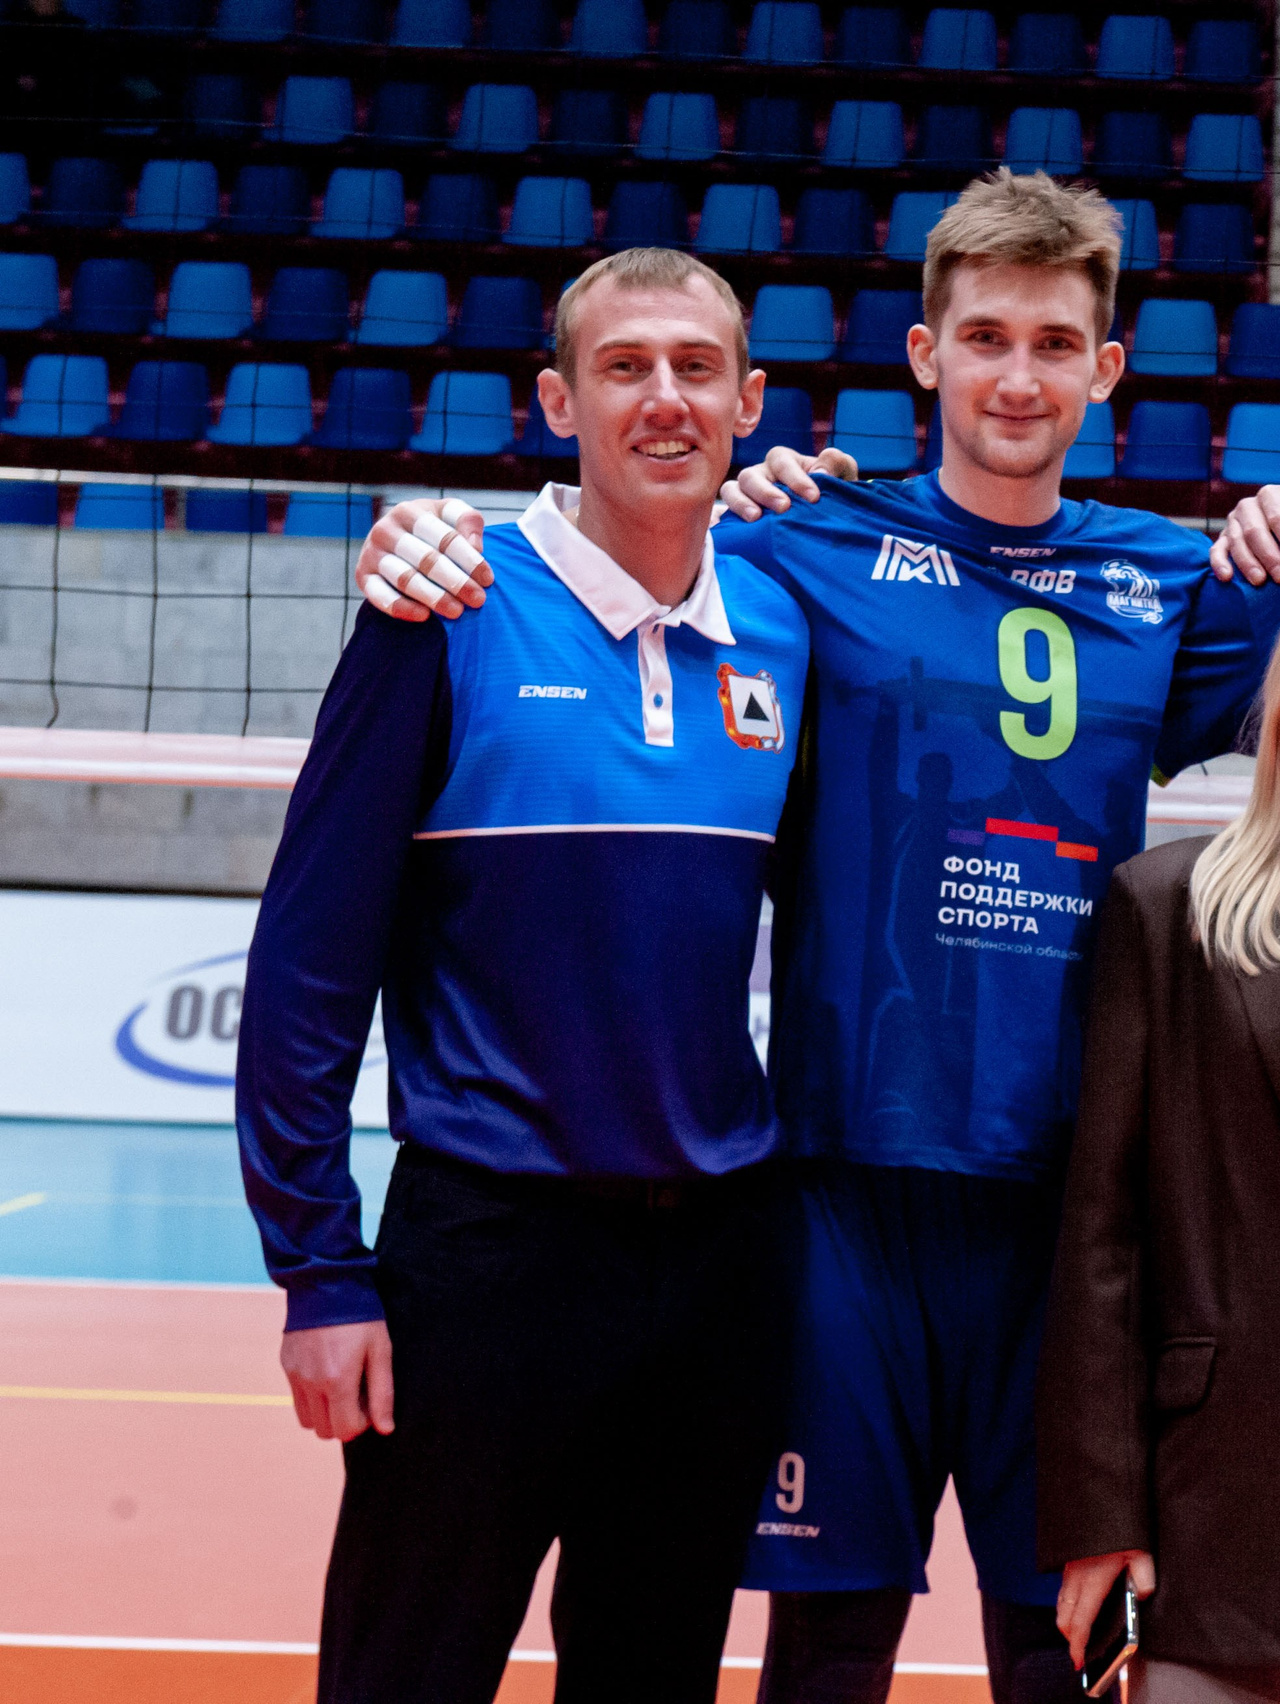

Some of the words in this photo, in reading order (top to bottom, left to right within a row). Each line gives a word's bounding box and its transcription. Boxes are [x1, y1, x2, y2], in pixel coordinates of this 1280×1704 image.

[989, 546, 1057, 558] ENSEN
[518, 685, 587, 700] ENSEN
[997, 606, 1078, 761] 9
[943, 855, 1020, 884] ФОНД
[939, 880, 1094, 917] ПОДДЕРЖКИ
[937, 906, 1039, 935] СПОРТА
[936, 933, 1033, 954] Челябинской
[775, 1451, 806, 1513] 9
[756, 1522, 820, 1537] ENSEN
